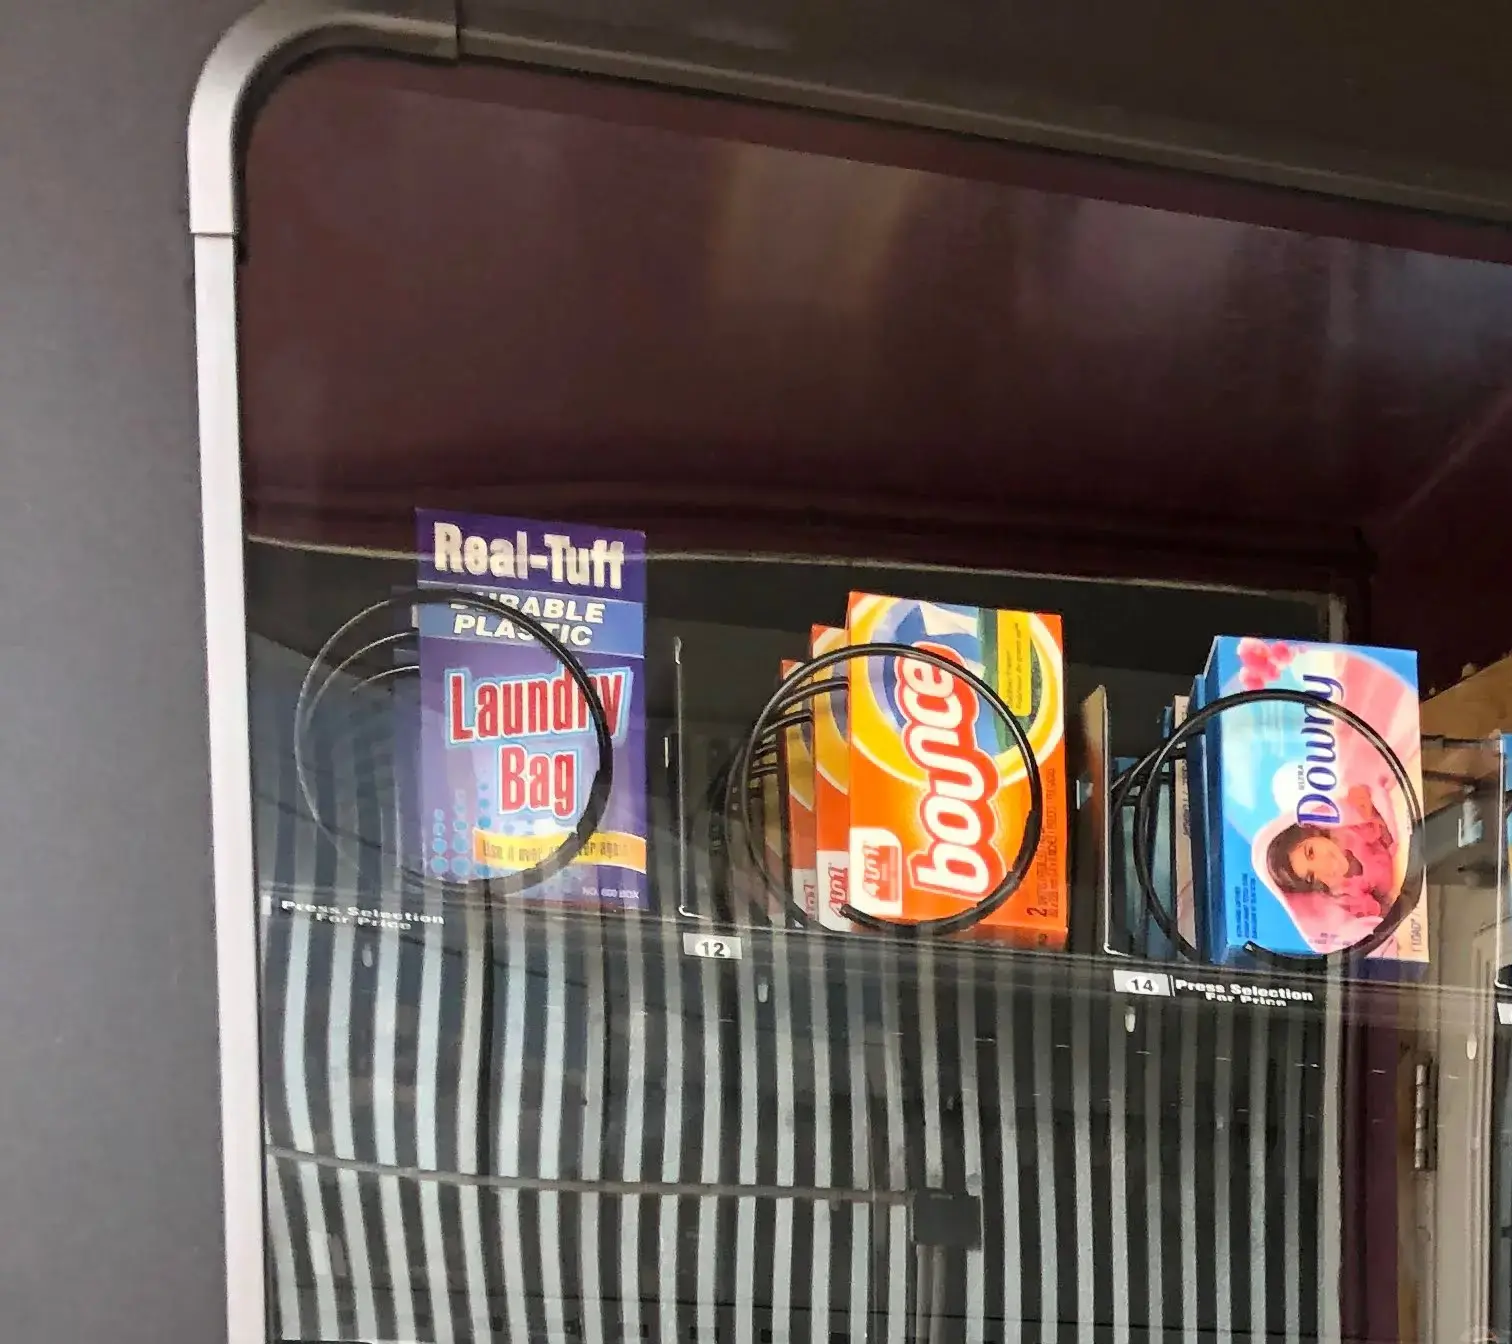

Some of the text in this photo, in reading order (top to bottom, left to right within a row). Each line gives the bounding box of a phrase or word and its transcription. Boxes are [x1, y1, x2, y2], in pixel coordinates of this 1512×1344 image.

[433, 521, 625, 589] Real-Tuff
[500, 746, 576, 817] Bag
[902, 652, 990, 894] bounce
[1296, 674, 1345, 826] Downy
[701, 941, 727, 958] 12
[1132, 979, 1154, 991] 14
